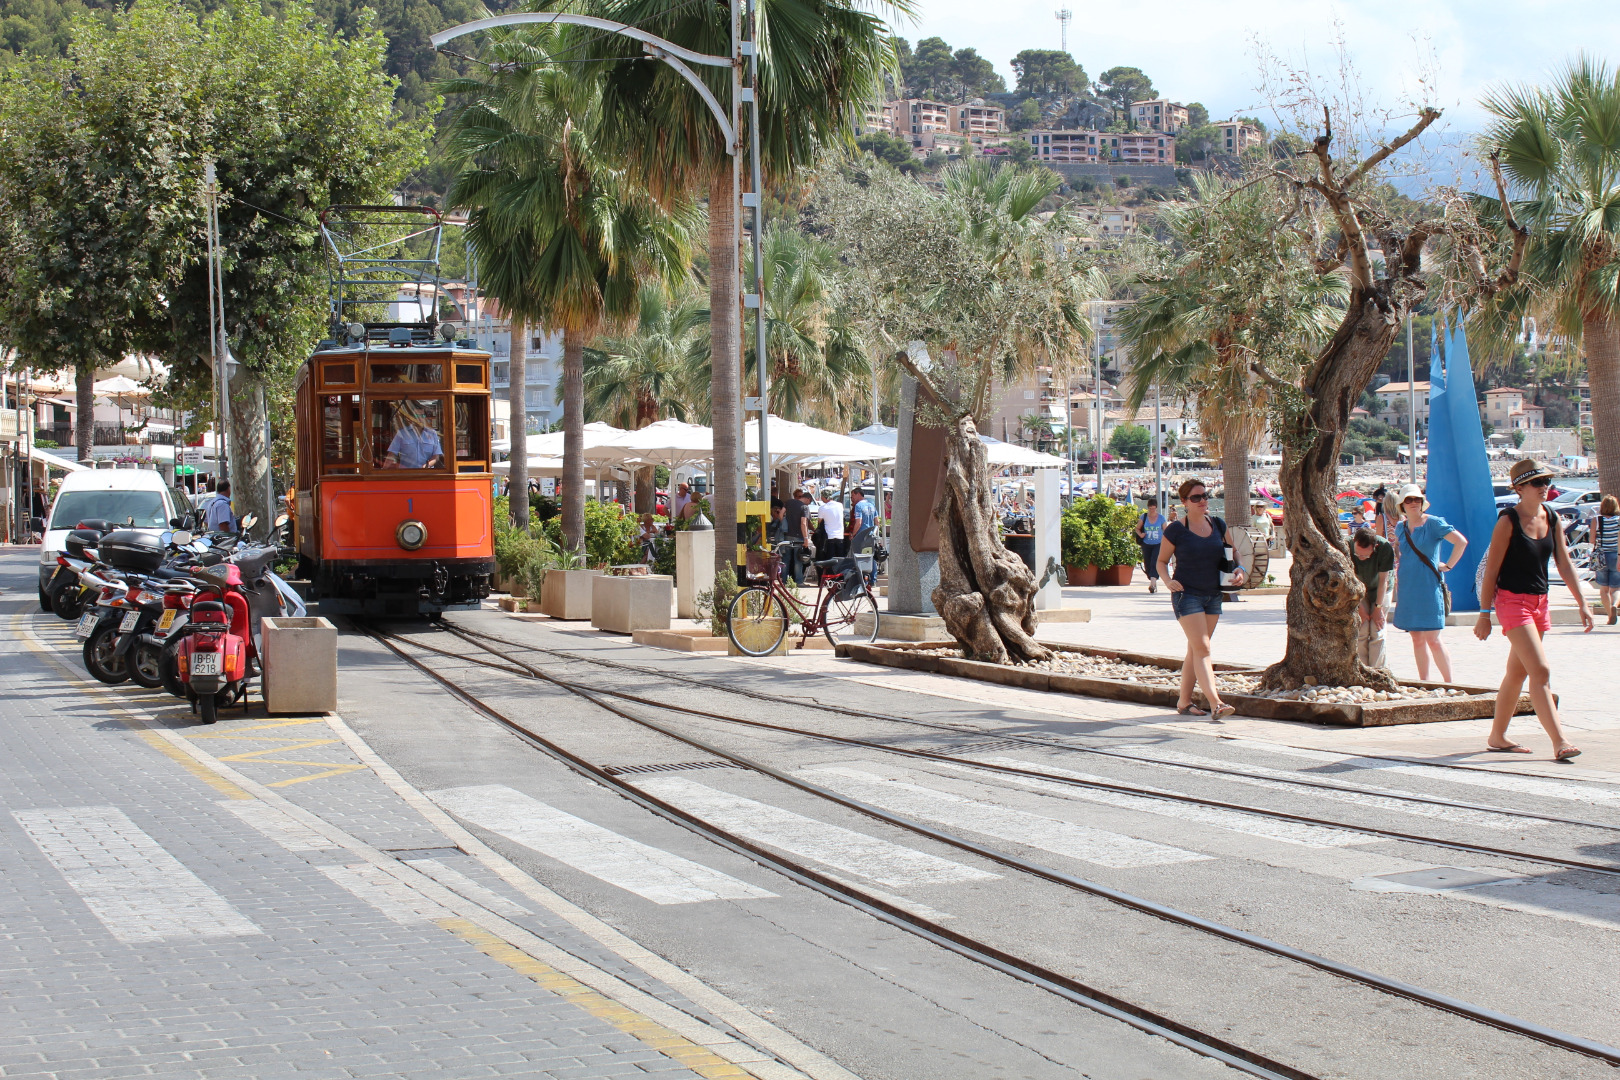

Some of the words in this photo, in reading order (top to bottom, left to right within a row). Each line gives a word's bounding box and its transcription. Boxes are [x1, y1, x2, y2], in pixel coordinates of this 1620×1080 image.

[407, 498, 413, 513] 1
[1147, 531, 1159, 539] 76
[194, 654, 216, 663] IB-BV
[195, 664, 216, 674] 6218
